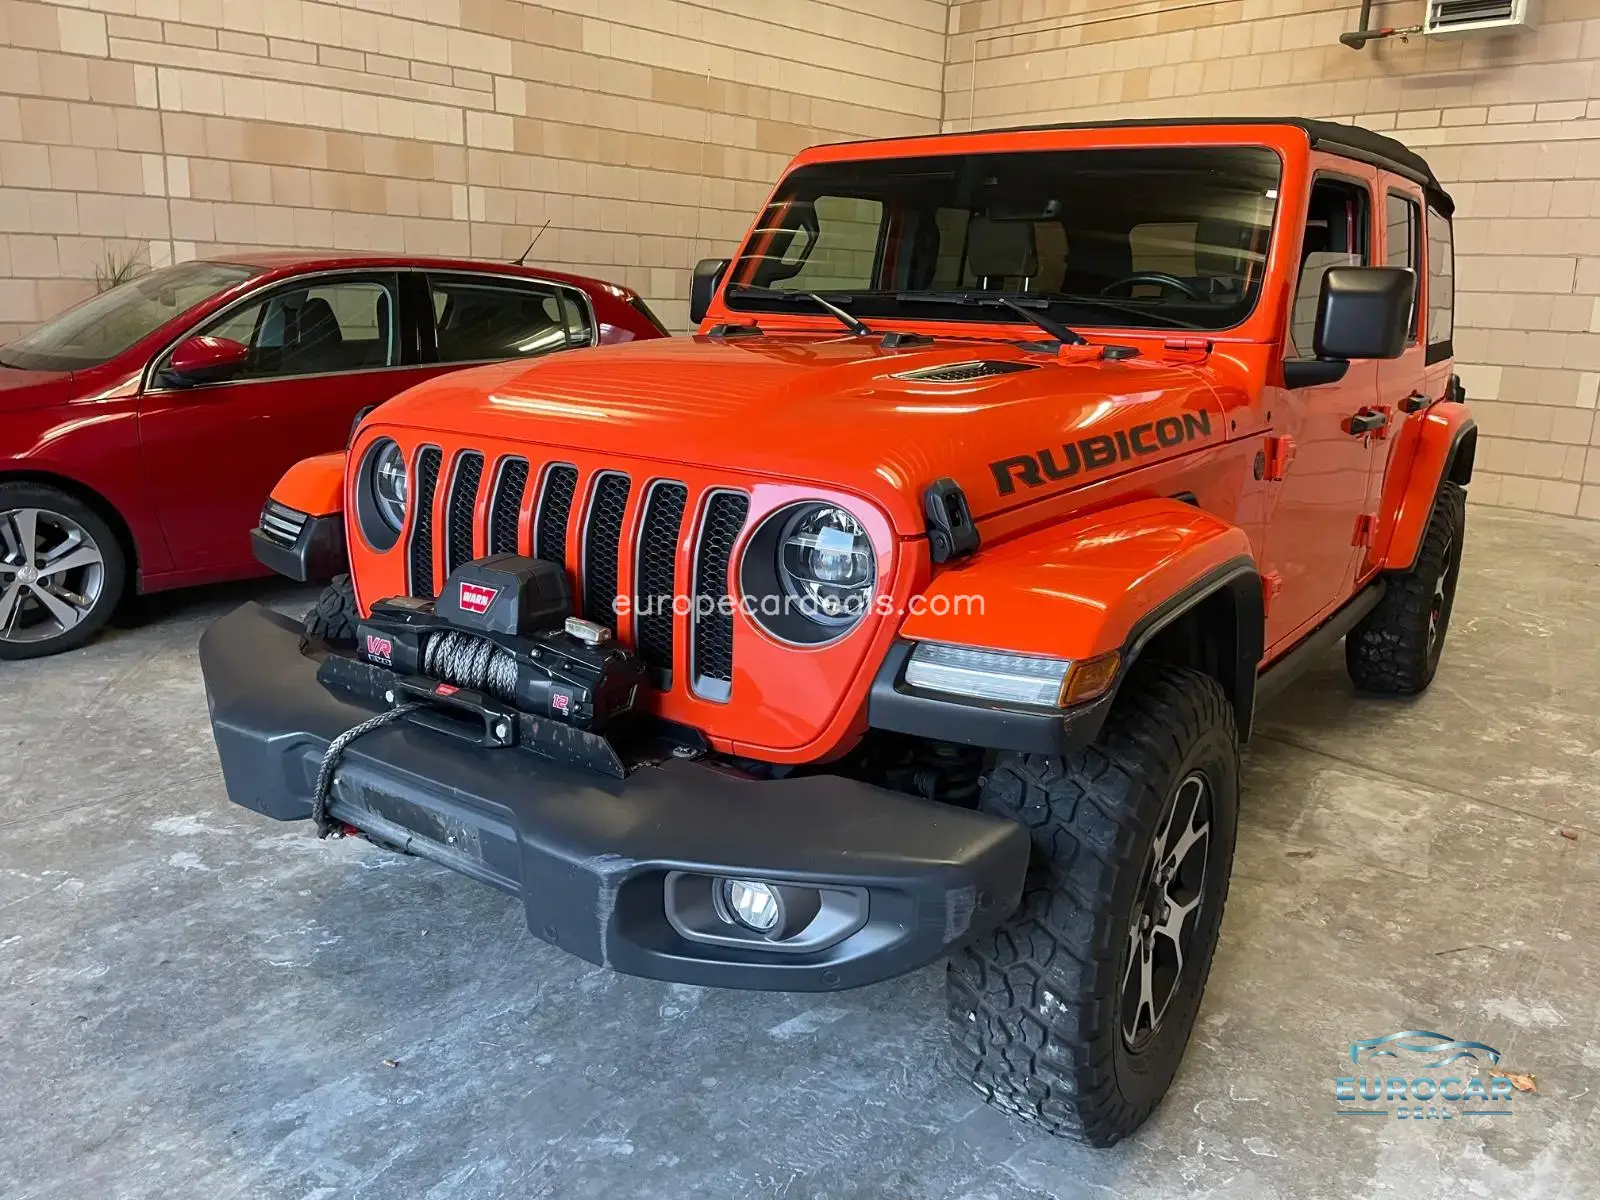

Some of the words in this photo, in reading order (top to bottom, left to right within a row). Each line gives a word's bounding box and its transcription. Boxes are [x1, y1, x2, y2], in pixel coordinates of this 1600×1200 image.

[988, 409, 1212, 497] RUBICON
[463, 591, 489, 606] WARN
[367, 634, 392, 660] VR
[552, 693, 569, 710] 12
